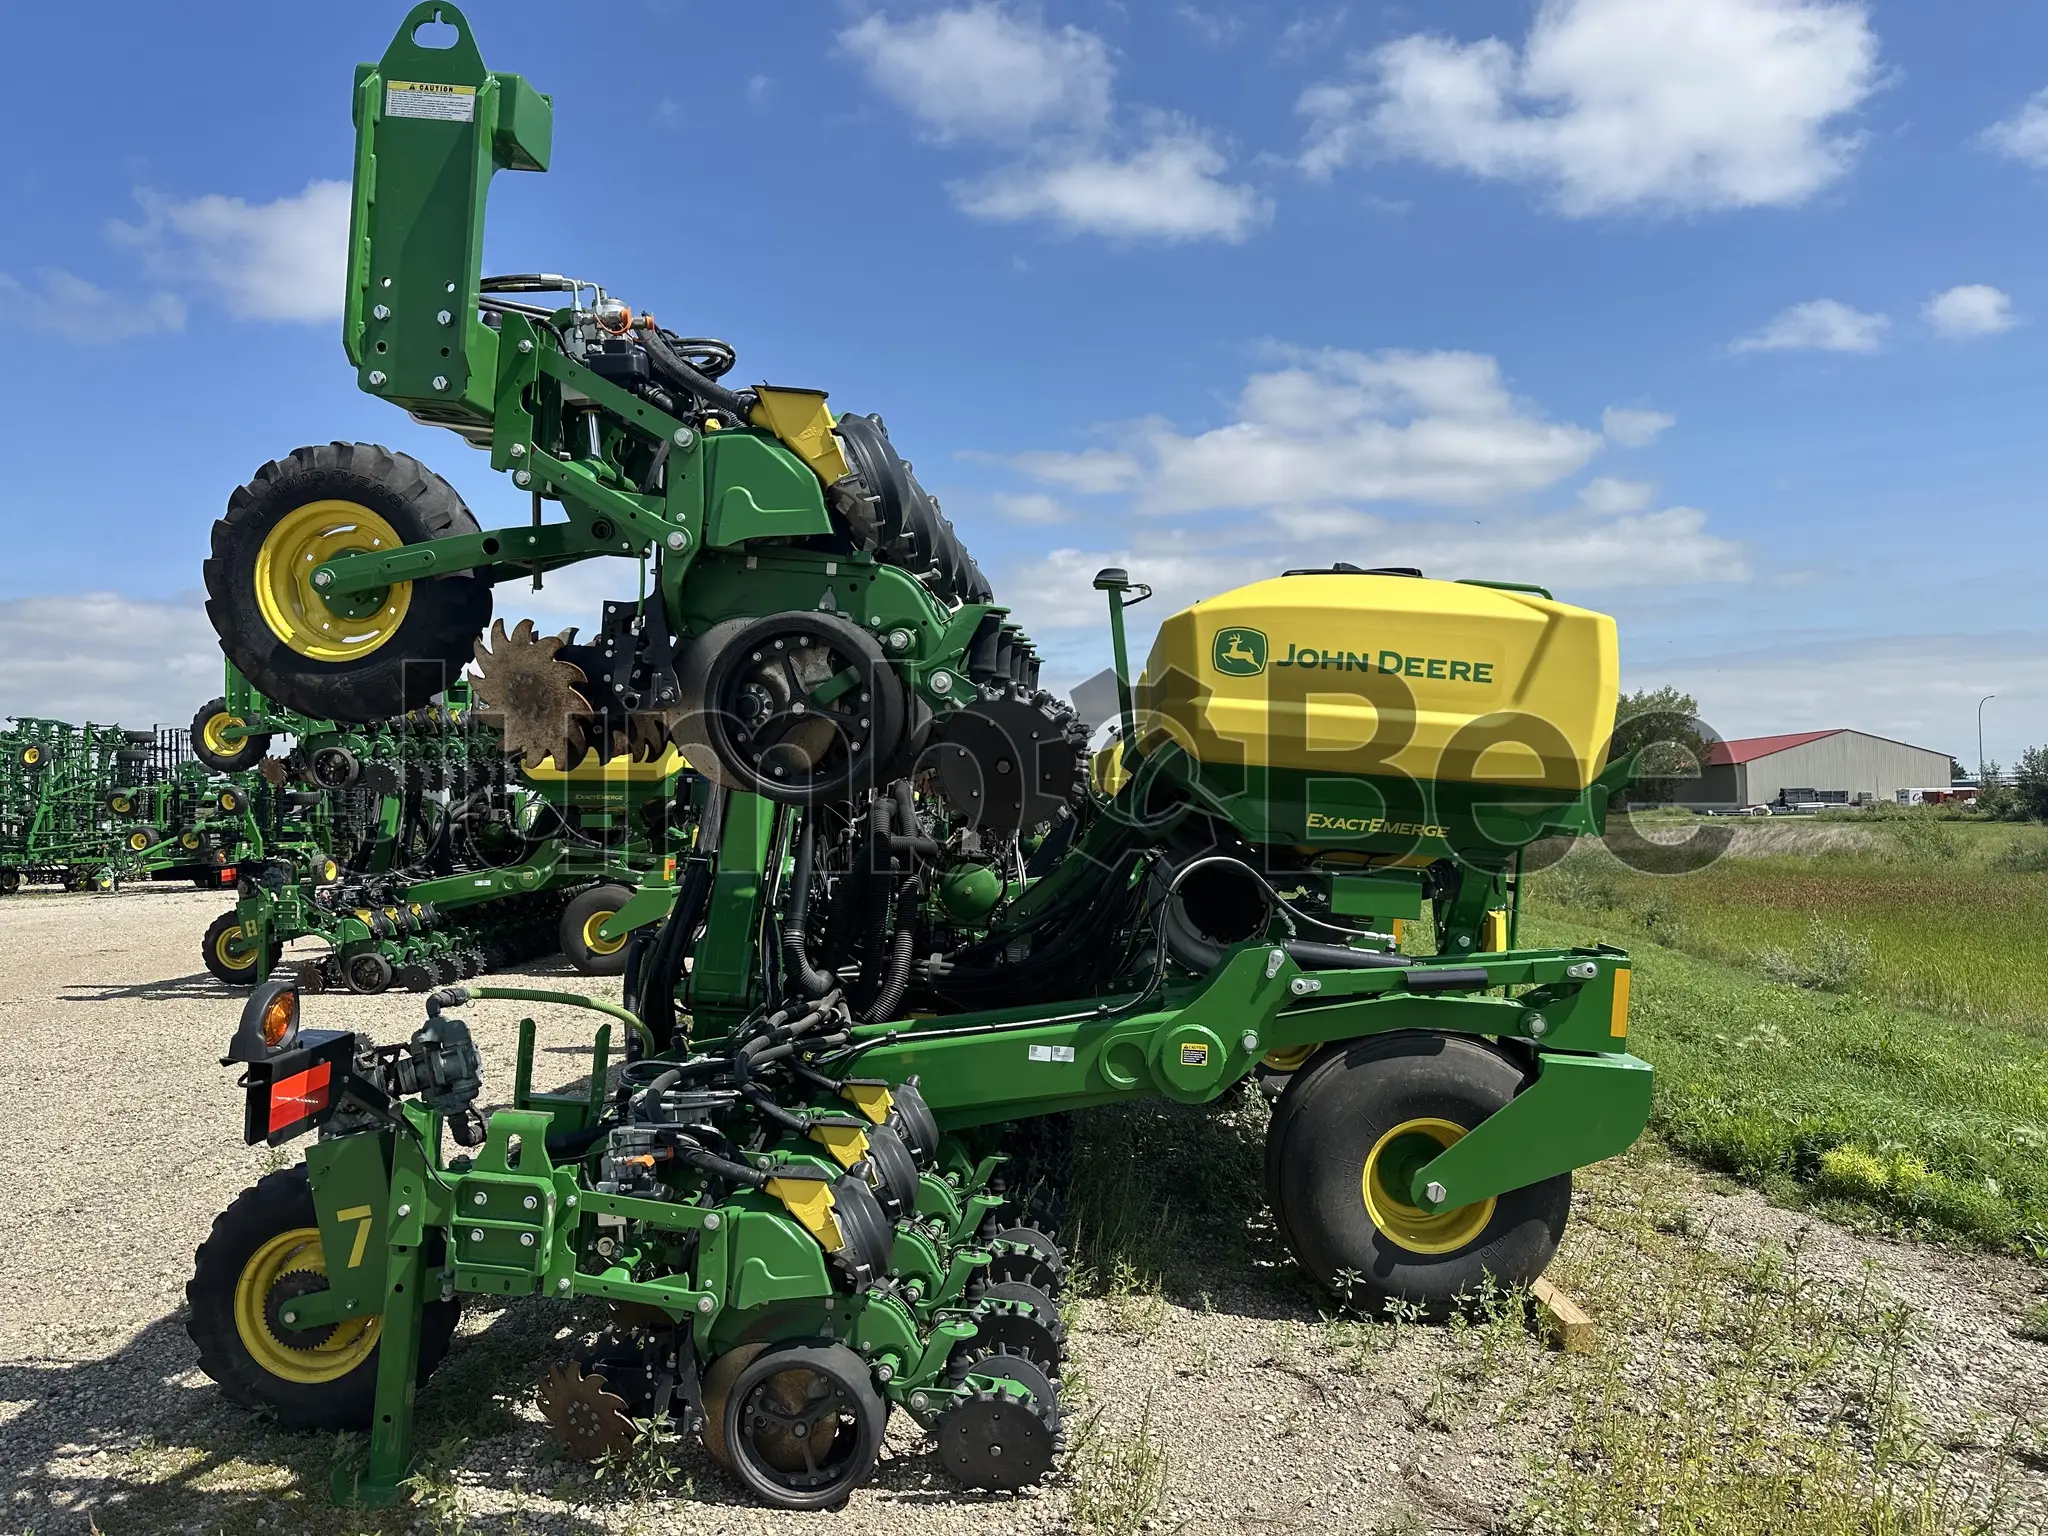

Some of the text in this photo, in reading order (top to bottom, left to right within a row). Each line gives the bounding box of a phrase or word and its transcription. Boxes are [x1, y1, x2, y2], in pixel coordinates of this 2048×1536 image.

[419, 84, 454, 93] CAUTION
[1276, 643, 1494, 684] JOHN DEERE
[336, 1204, 373, 1269] 7
